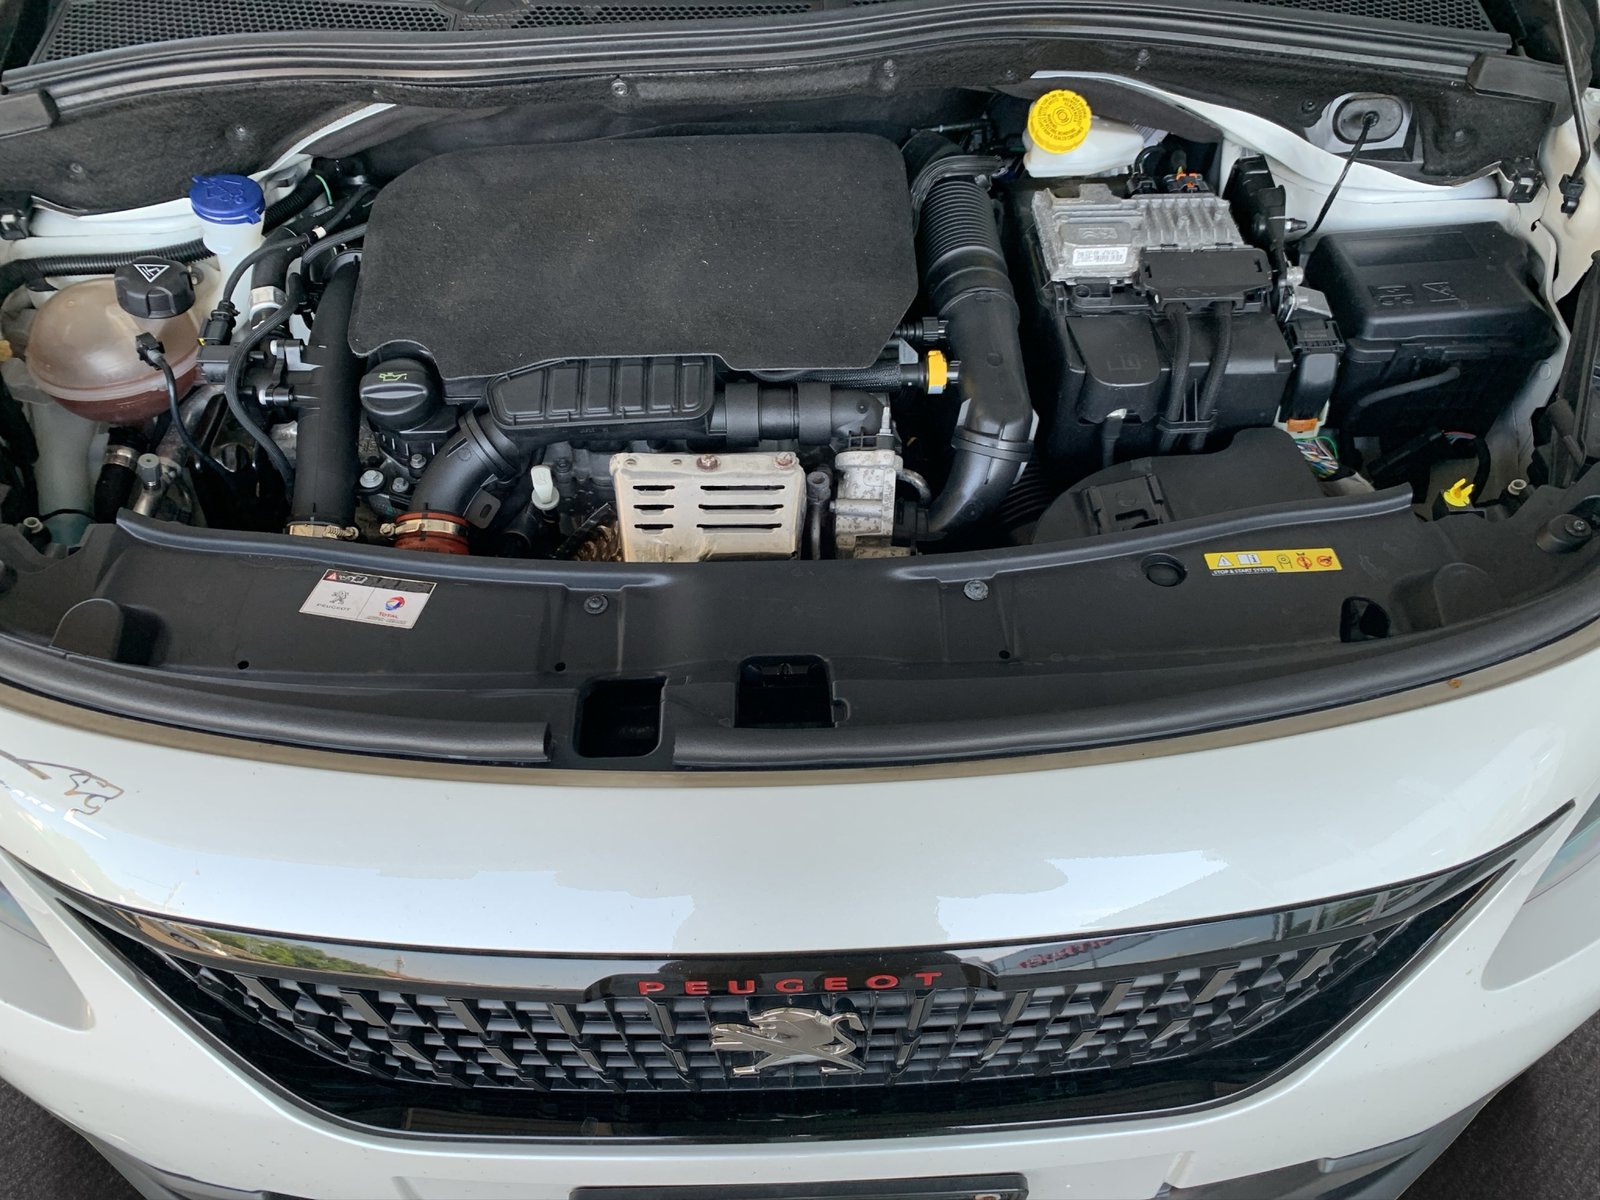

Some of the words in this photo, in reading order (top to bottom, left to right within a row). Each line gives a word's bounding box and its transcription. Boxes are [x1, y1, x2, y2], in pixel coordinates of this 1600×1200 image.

[316, 603, 351, 612] PEUGEOT
[378, 611, 398, 619] TOTAL
[638, 972, 943, 995] PEUGEOT
